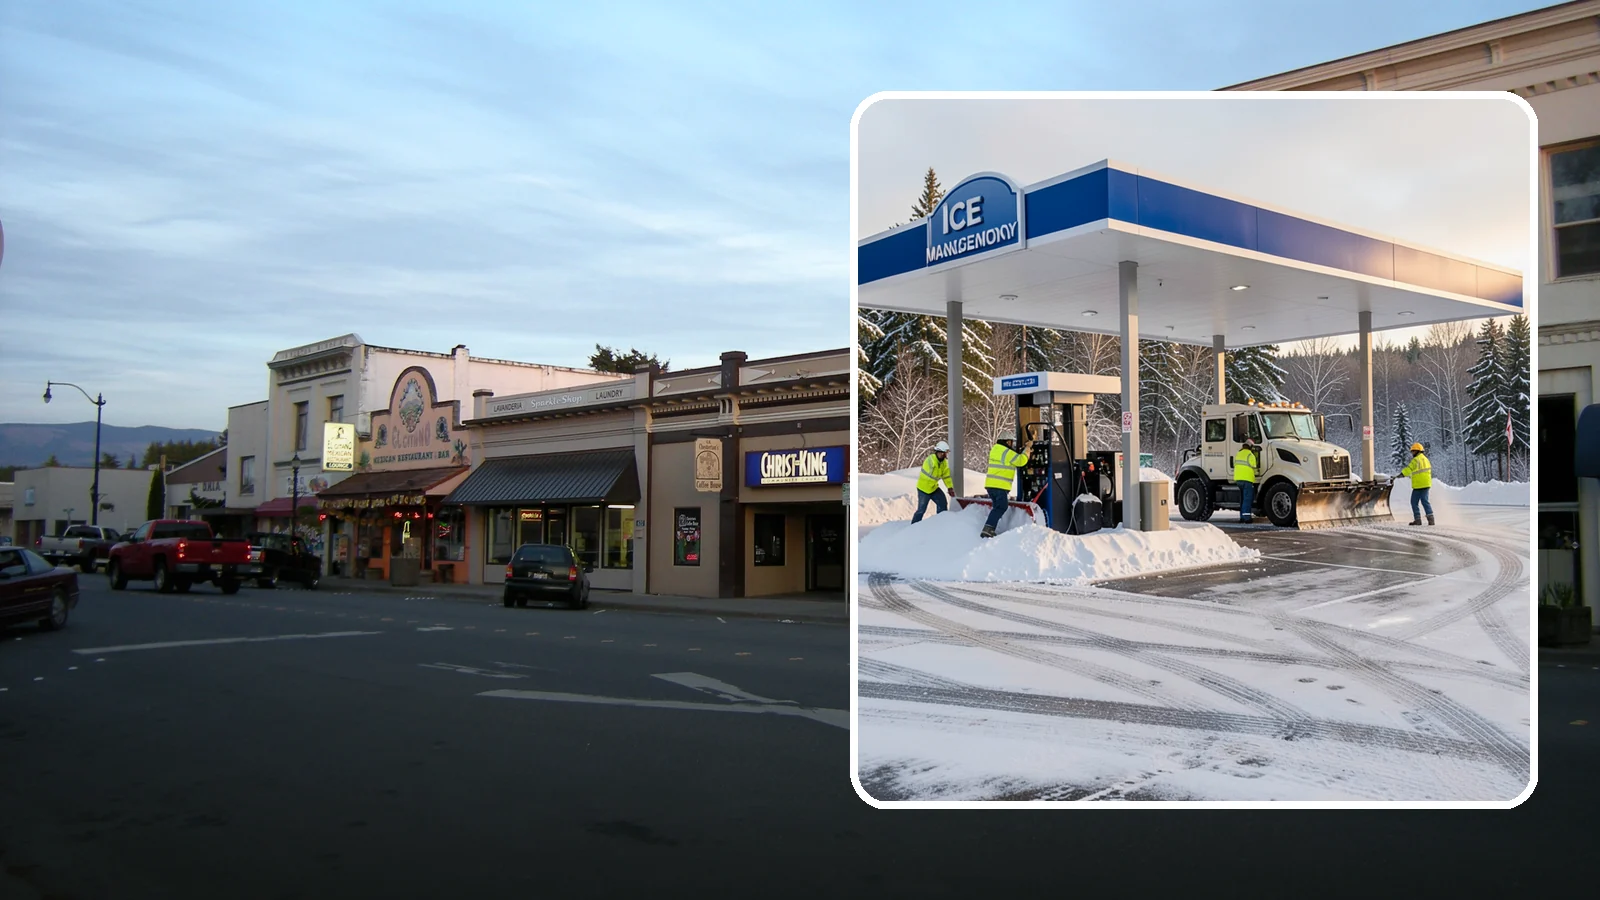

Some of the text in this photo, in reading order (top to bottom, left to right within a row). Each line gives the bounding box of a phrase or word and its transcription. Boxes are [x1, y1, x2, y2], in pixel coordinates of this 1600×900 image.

[943, 196, 982, 235] ICE
[561, 394, 583, 405] Shop
[595, 389, 623, 400] LAUNDRY
[493, 402, 522, 412] LAVANDERIA
[373, 450, 450, 464] MEXICAN RESTAURANT BAR
[761, 452, 797, 478] CHRIST
[799, 450, 827, 476] KING
